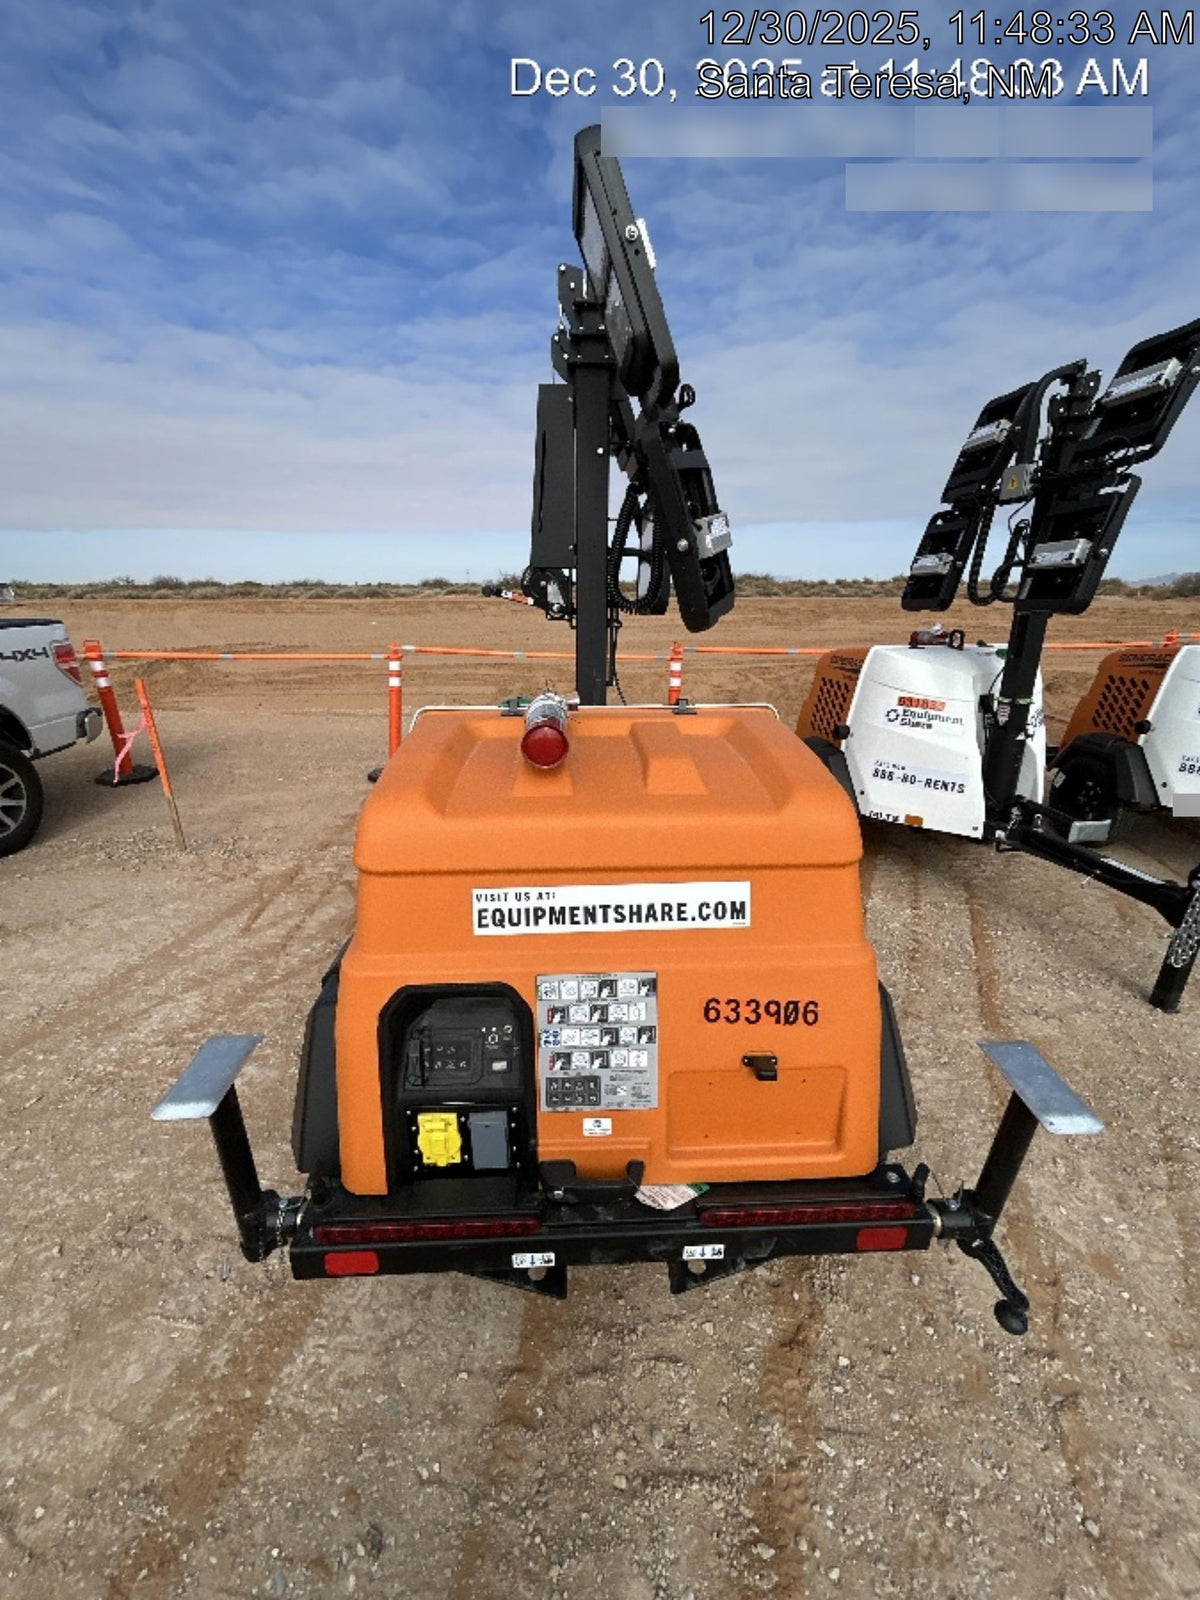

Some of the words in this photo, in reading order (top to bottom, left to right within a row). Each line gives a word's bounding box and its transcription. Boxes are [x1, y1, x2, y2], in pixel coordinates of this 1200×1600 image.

[475, 892, 510, 903] VISIT
[514, 892, 531, 902] US
[476, 900, 747, 929] EQUIPMENTSHARE.COM
[703, 997, 819, 1026] 633906
